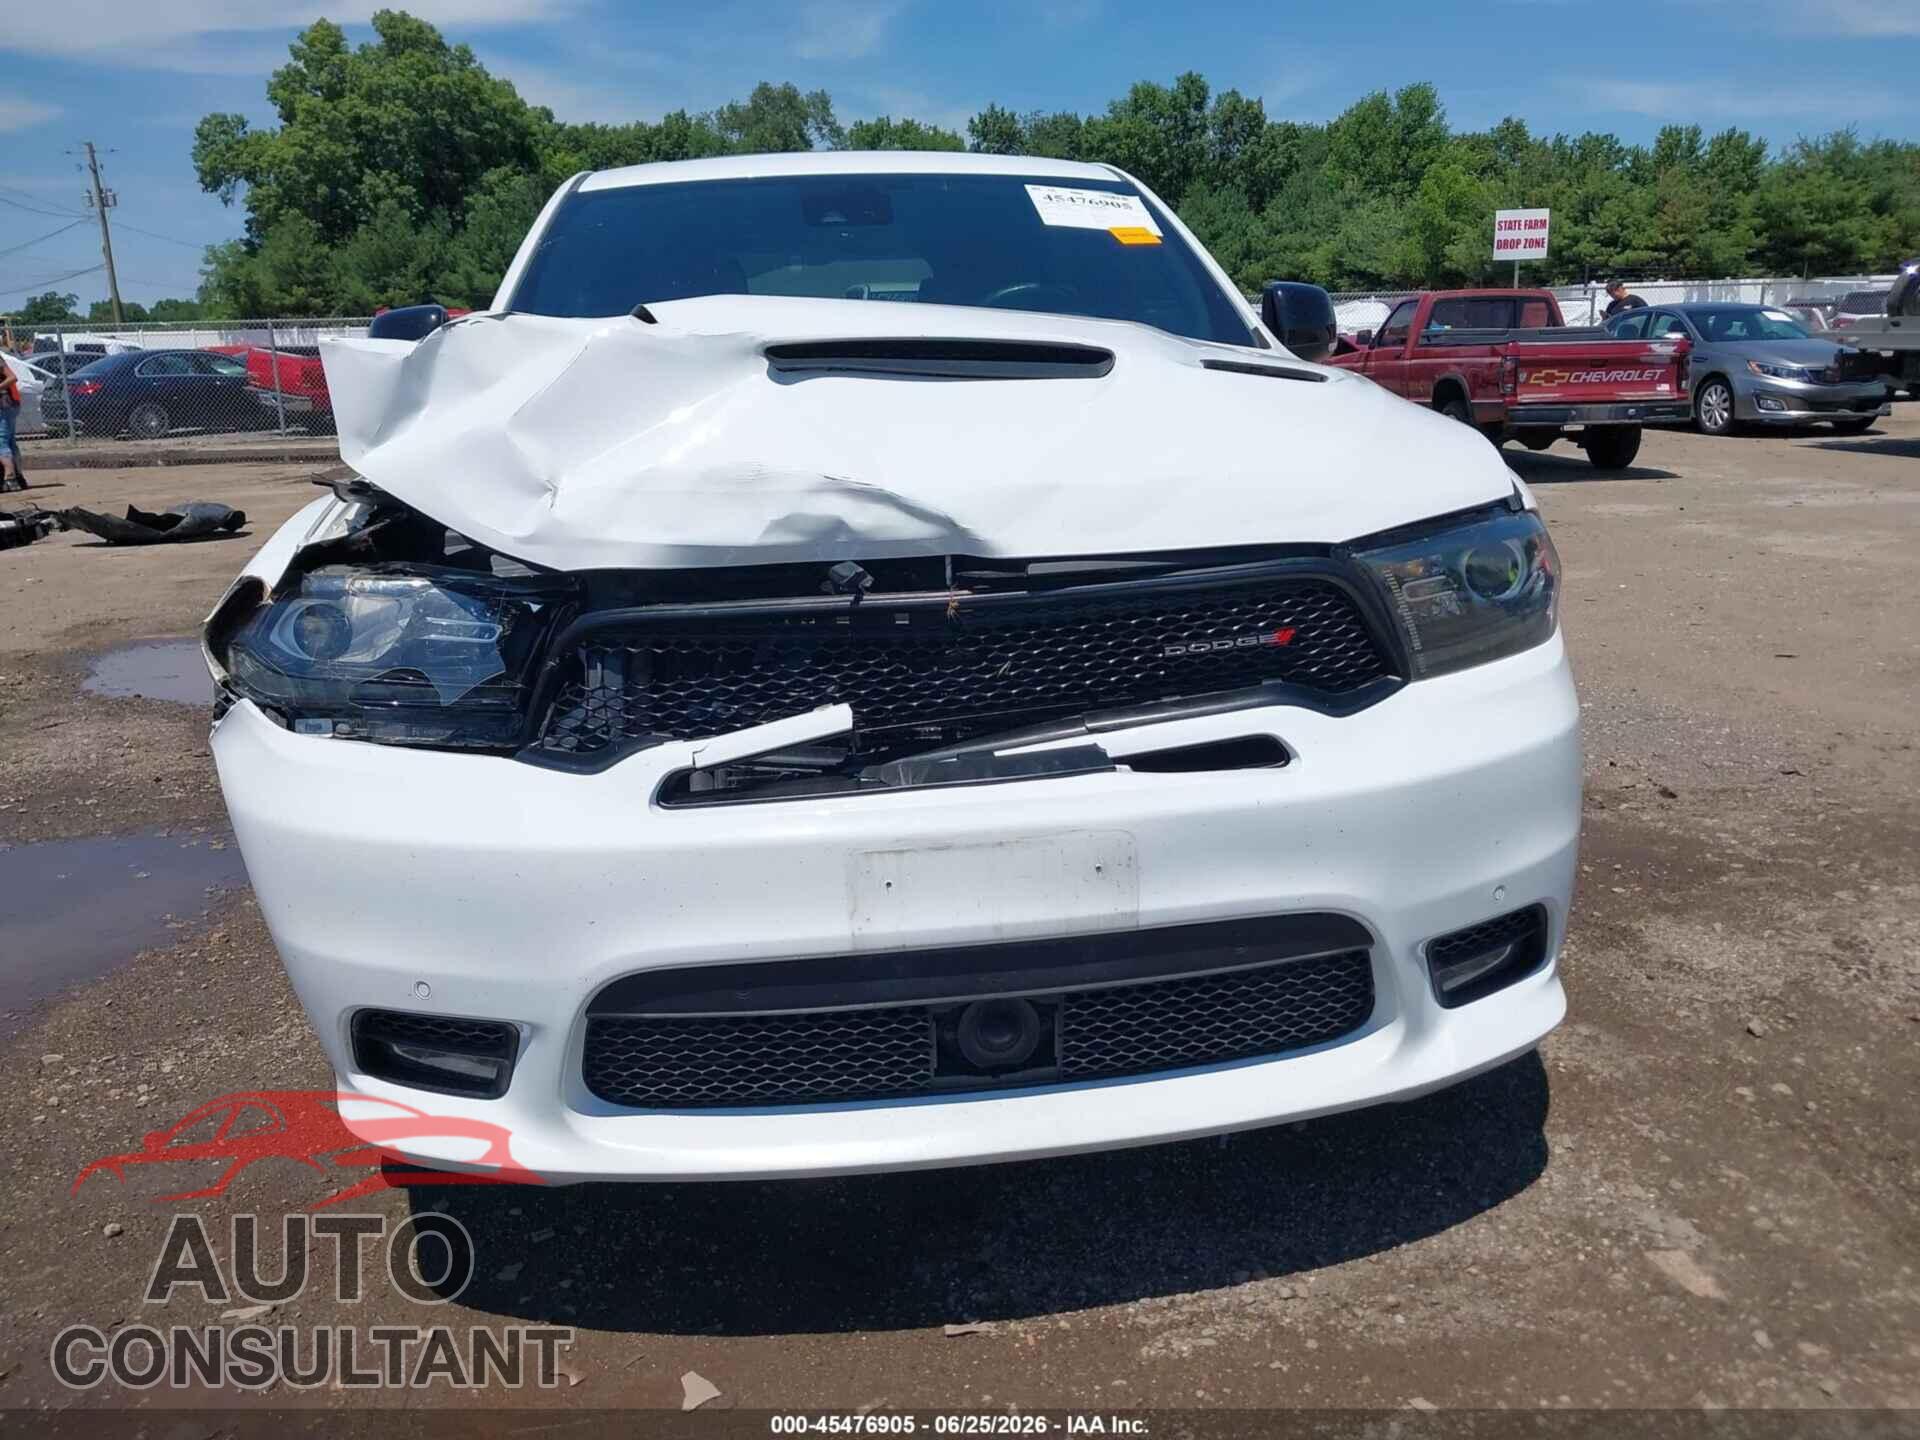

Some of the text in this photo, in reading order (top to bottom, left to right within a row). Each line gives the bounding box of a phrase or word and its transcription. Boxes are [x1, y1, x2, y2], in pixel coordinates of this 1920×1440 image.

[1043, 193, 1133, 210] 45476905
[1497, 219, 1547, 231] STATE FARM
[1496, 238, 1546, 250] DROP ZONE
[1569, 369, 1665, 383] CHEVROLET
[1164, 634, 1280, 656] DODGE
